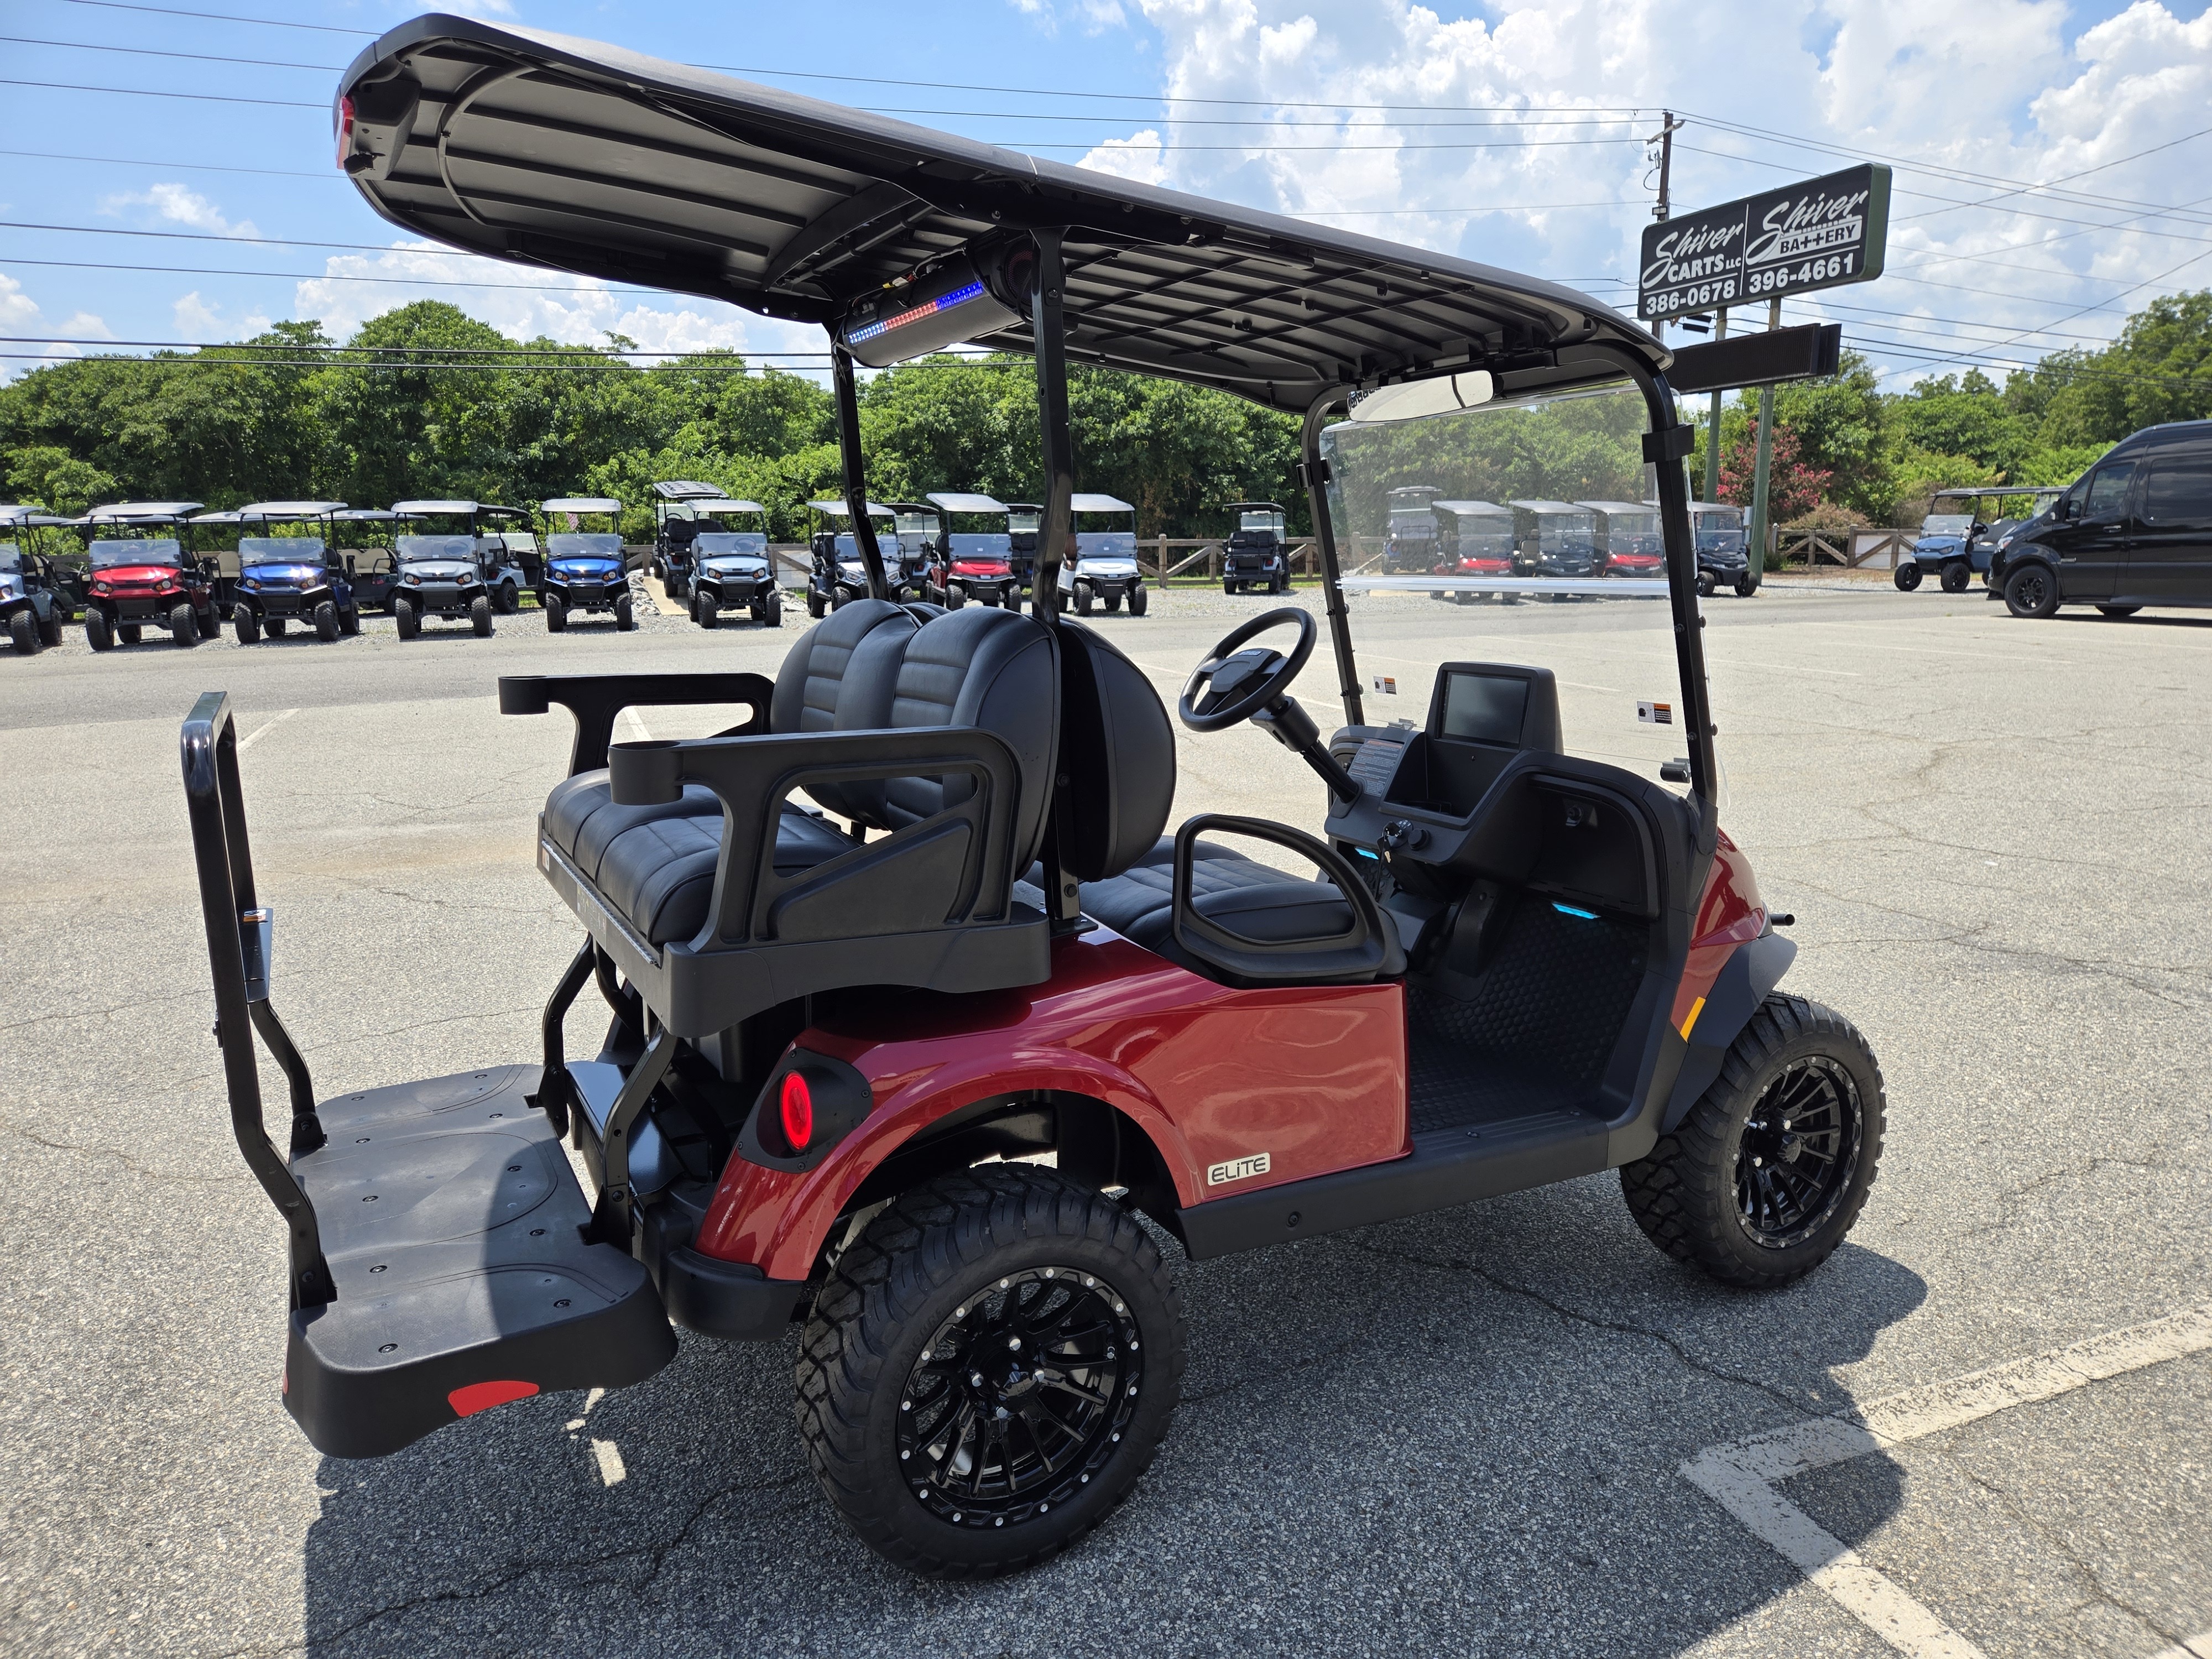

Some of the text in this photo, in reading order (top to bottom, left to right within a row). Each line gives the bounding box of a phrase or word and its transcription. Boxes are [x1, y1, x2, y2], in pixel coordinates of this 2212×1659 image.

[1746, 190, 1868, 265] Shiver
[1642, 223, 1744, 289] Shiver
[1667, 254, 1741, 283] CARTS LLC
[1750, 253, 1854, 294] 396-4661
[1646, 280, 1735, 315] 386-0678
